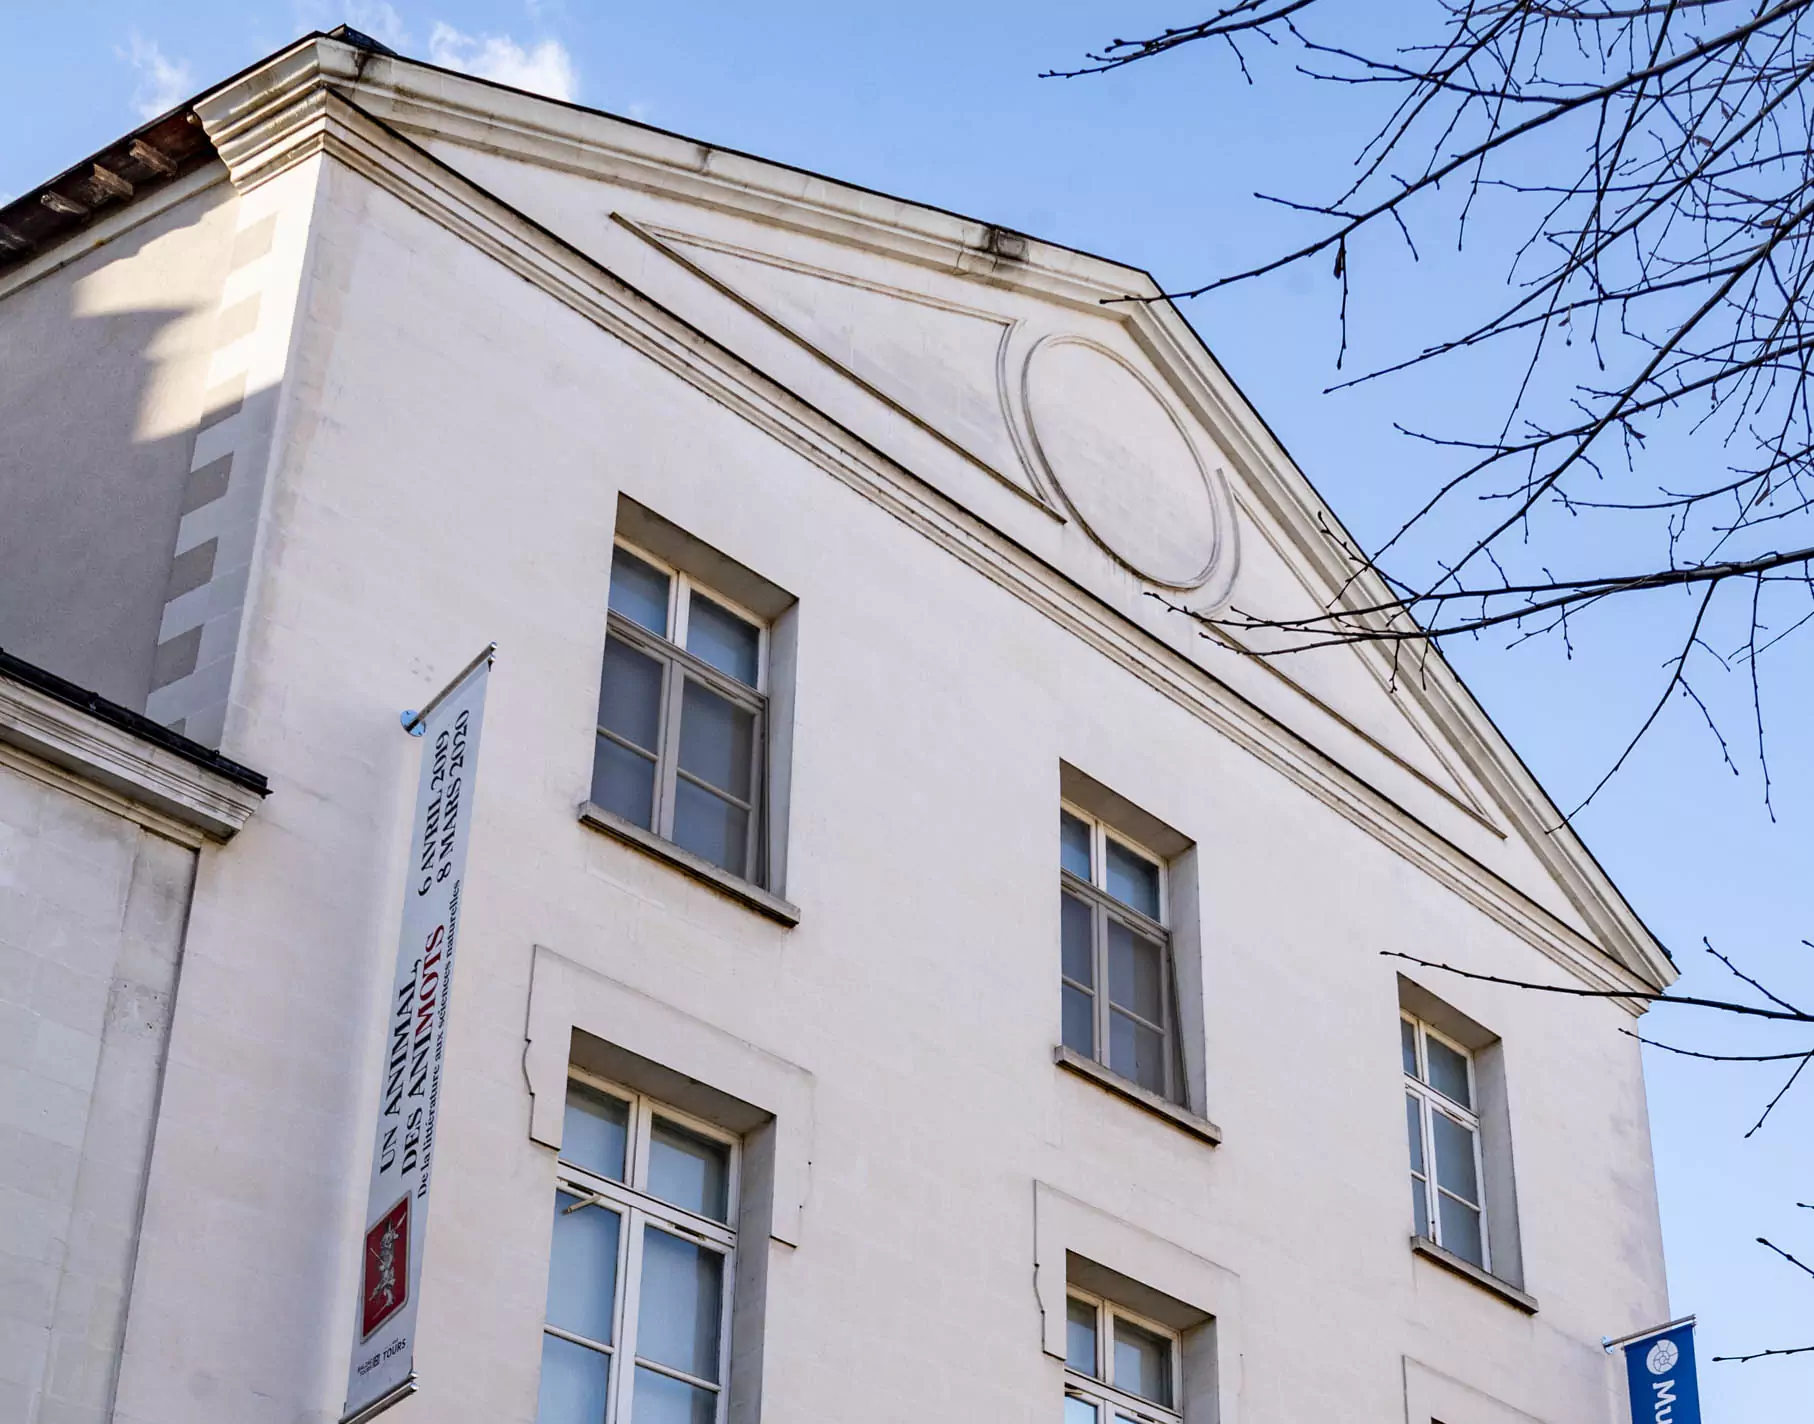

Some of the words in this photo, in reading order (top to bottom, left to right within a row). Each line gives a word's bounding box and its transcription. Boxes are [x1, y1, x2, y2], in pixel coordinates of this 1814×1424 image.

[431, 730, 449, 791] 2019
[449, 709, 469, 776] 2020
[421, 789, 442, 871] AVRIL
[439, 777, 461, 861] MARS
[418, 875, 432, 896] 6
[436, 861, 451, 882] 8
[447, 879, 460, 958] naturelles
[408, 924, 444, 1097] ANIMOTS
[438, 961, 451, 1028] sciences
[435, 1032, 443, 1061] aux
[380, 1126, 398, 1176] UN
[401, 1107, 422, 1178] DES
[421, 1152, 430, 1171] la
[417, 1173, 428, 1199] De
[383, 1339, 406, 1360] TOURS
